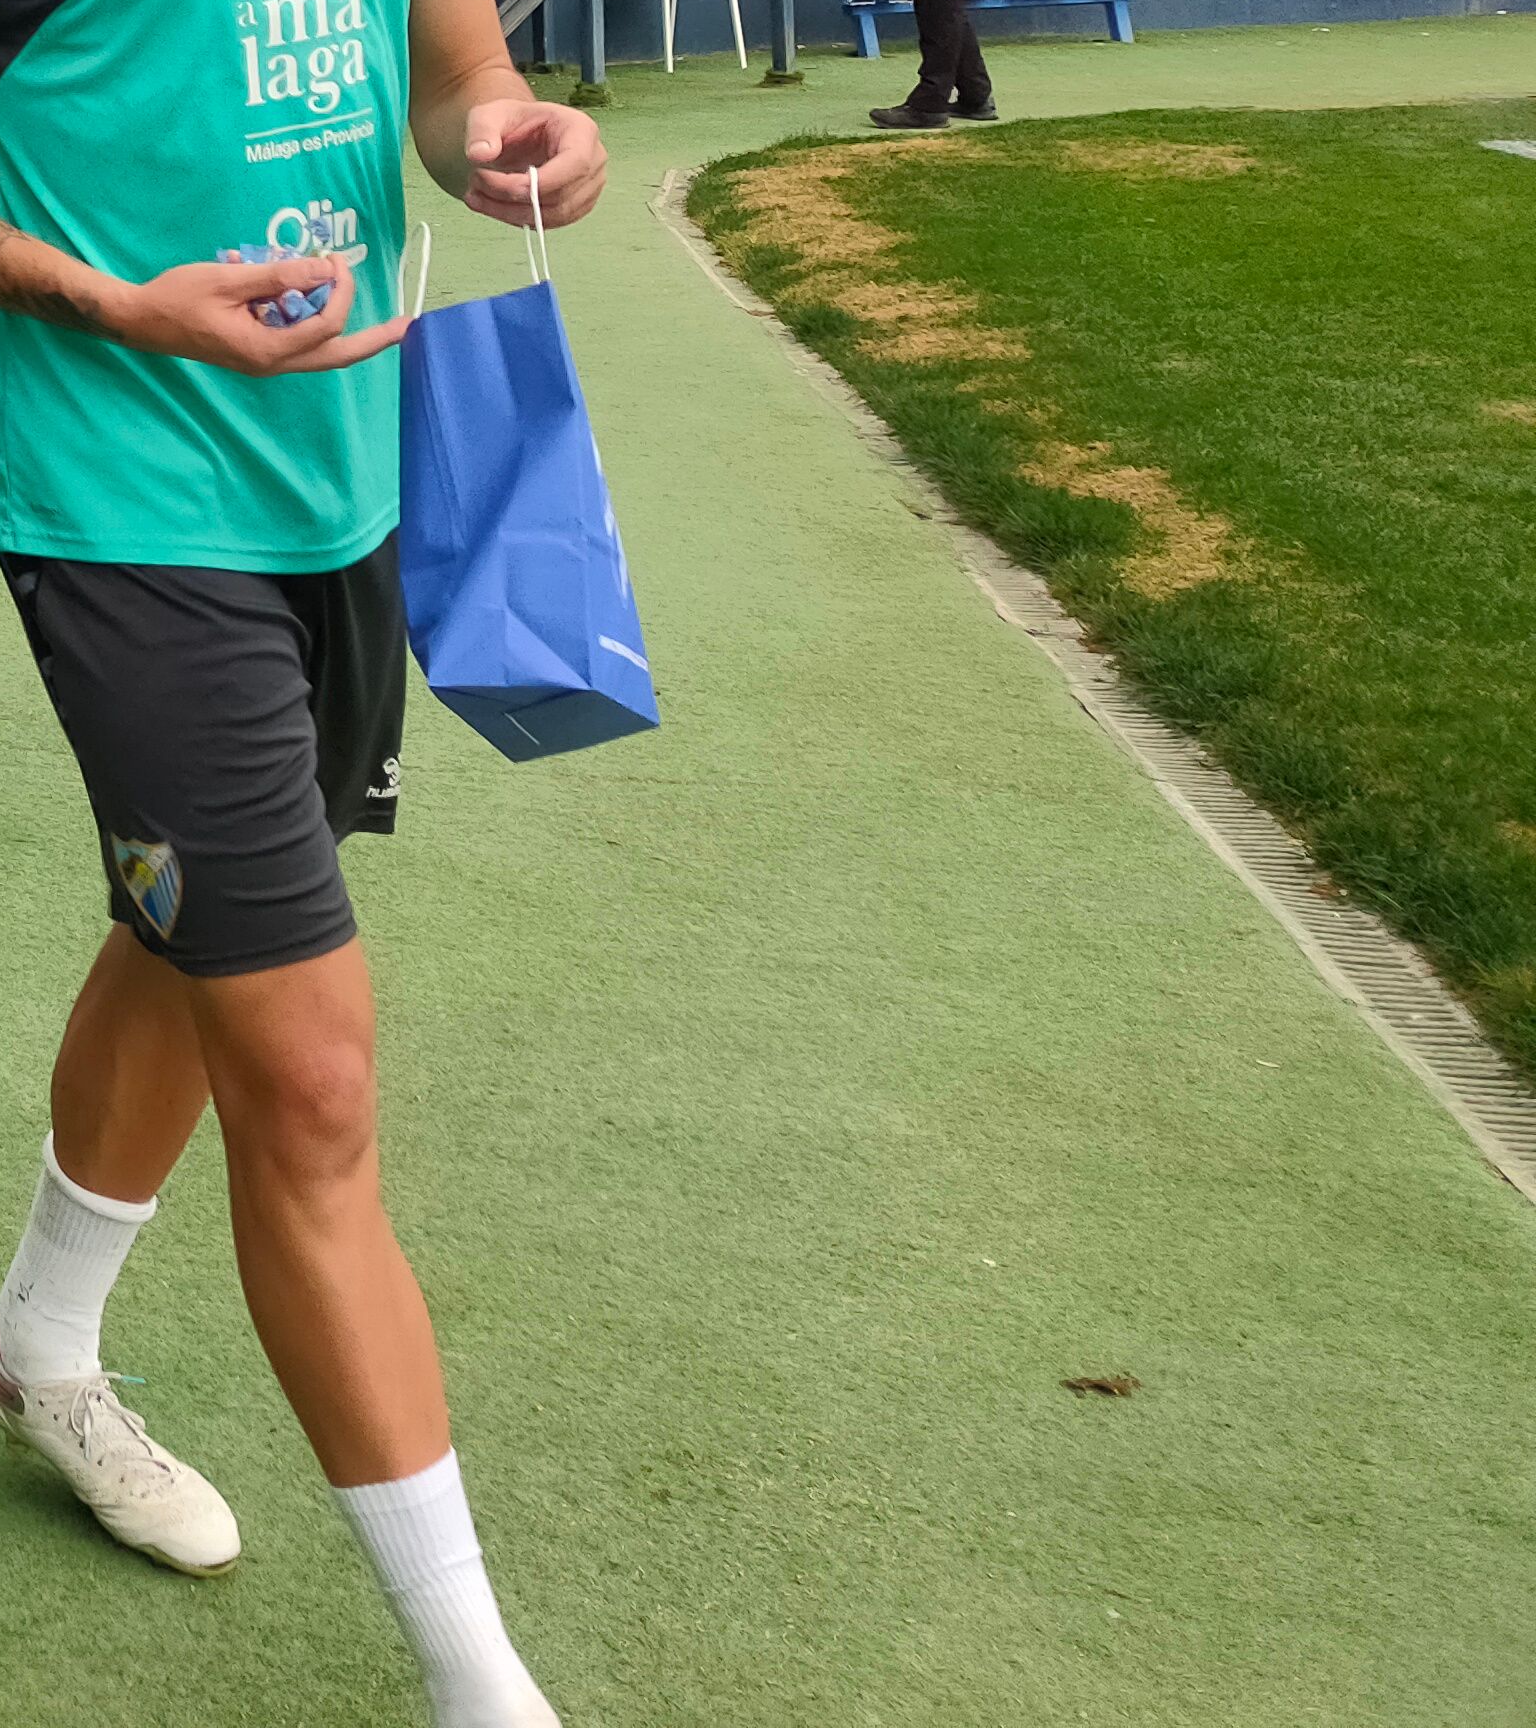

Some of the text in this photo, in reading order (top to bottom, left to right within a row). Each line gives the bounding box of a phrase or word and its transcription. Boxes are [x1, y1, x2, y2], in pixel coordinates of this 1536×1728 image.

[238, 1, 257, 27] a
[241, 35, 369, 114] laga
[245, 140, 301, 164] Málaga
[302, 135, 323, 152] es
